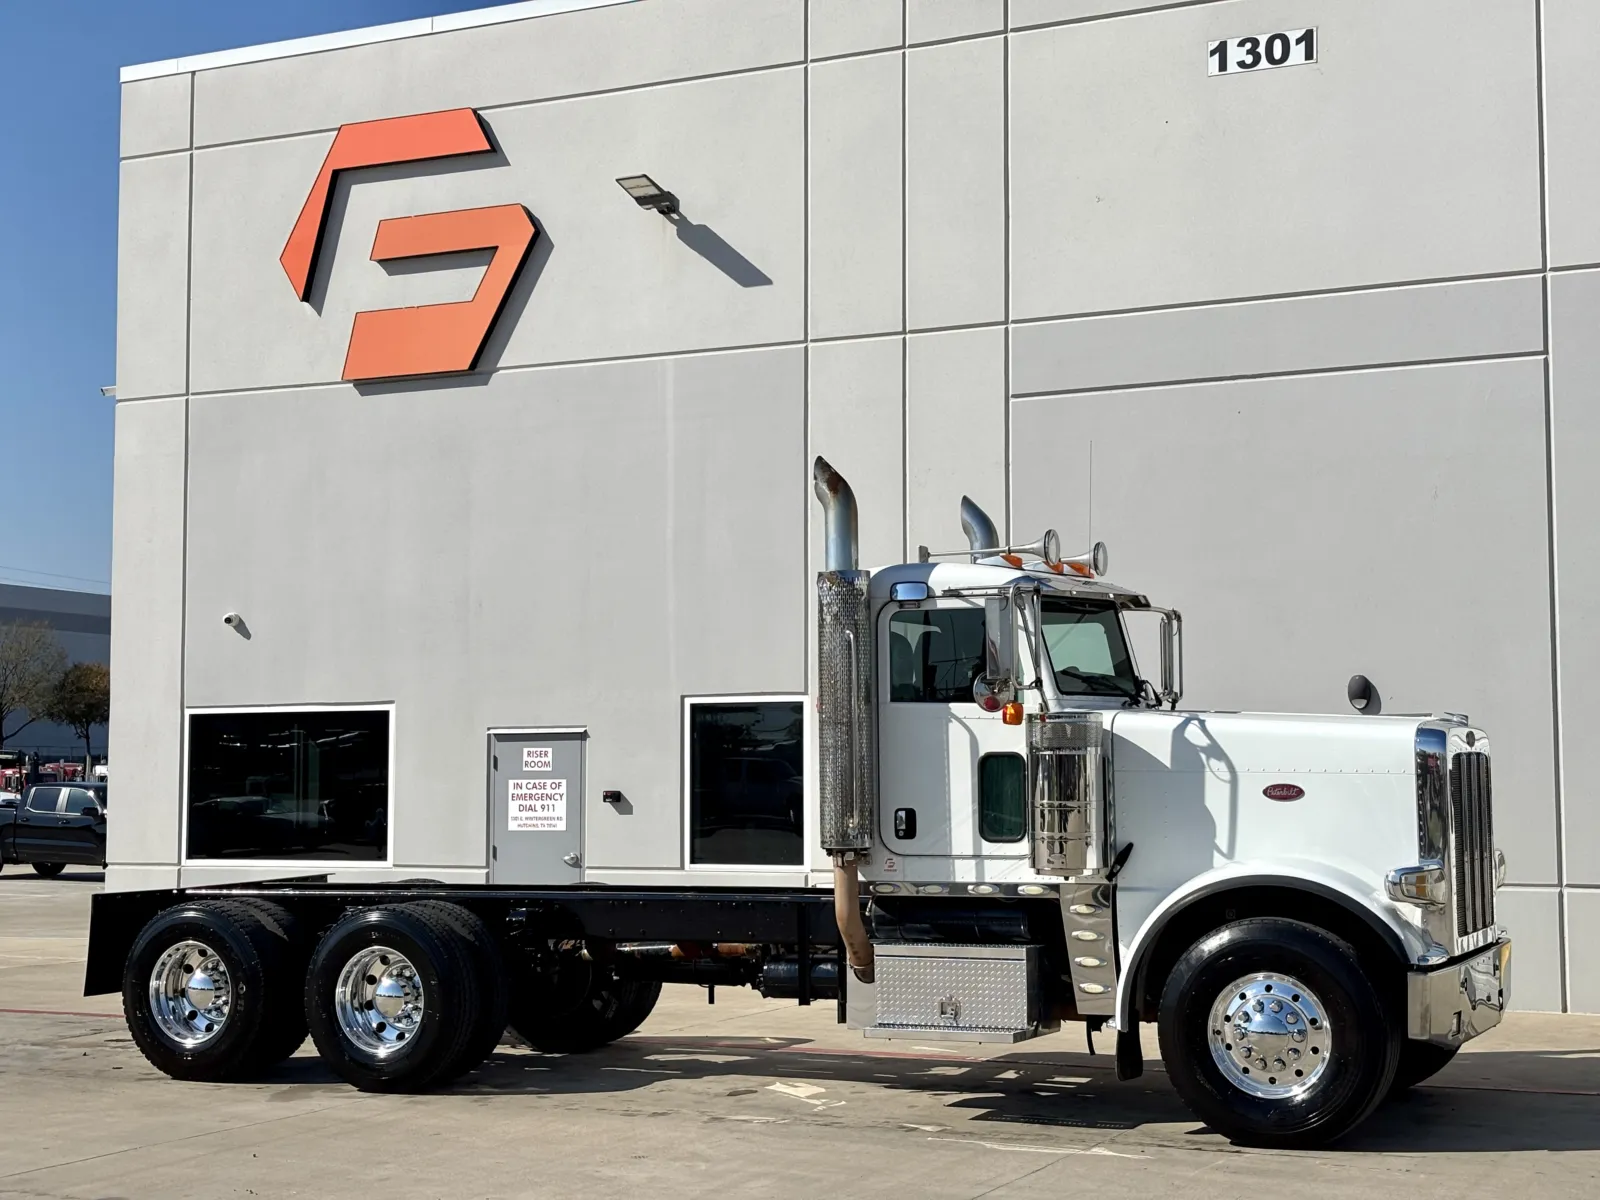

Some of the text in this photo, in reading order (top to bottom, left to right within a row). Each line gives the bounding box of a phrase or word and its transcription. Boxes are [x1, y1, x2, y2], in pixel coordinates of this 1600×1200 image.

[1209, 28, 1314, 73] 1301
[527, 750, 549, 758] RISER
[524, 760, 551, 768] ROOM
[513, 782, 562, 790] IN CASE OF
[511, 793, 564, 801] EMERGENCY
[518, 804, 555, 812] DIAL 911
